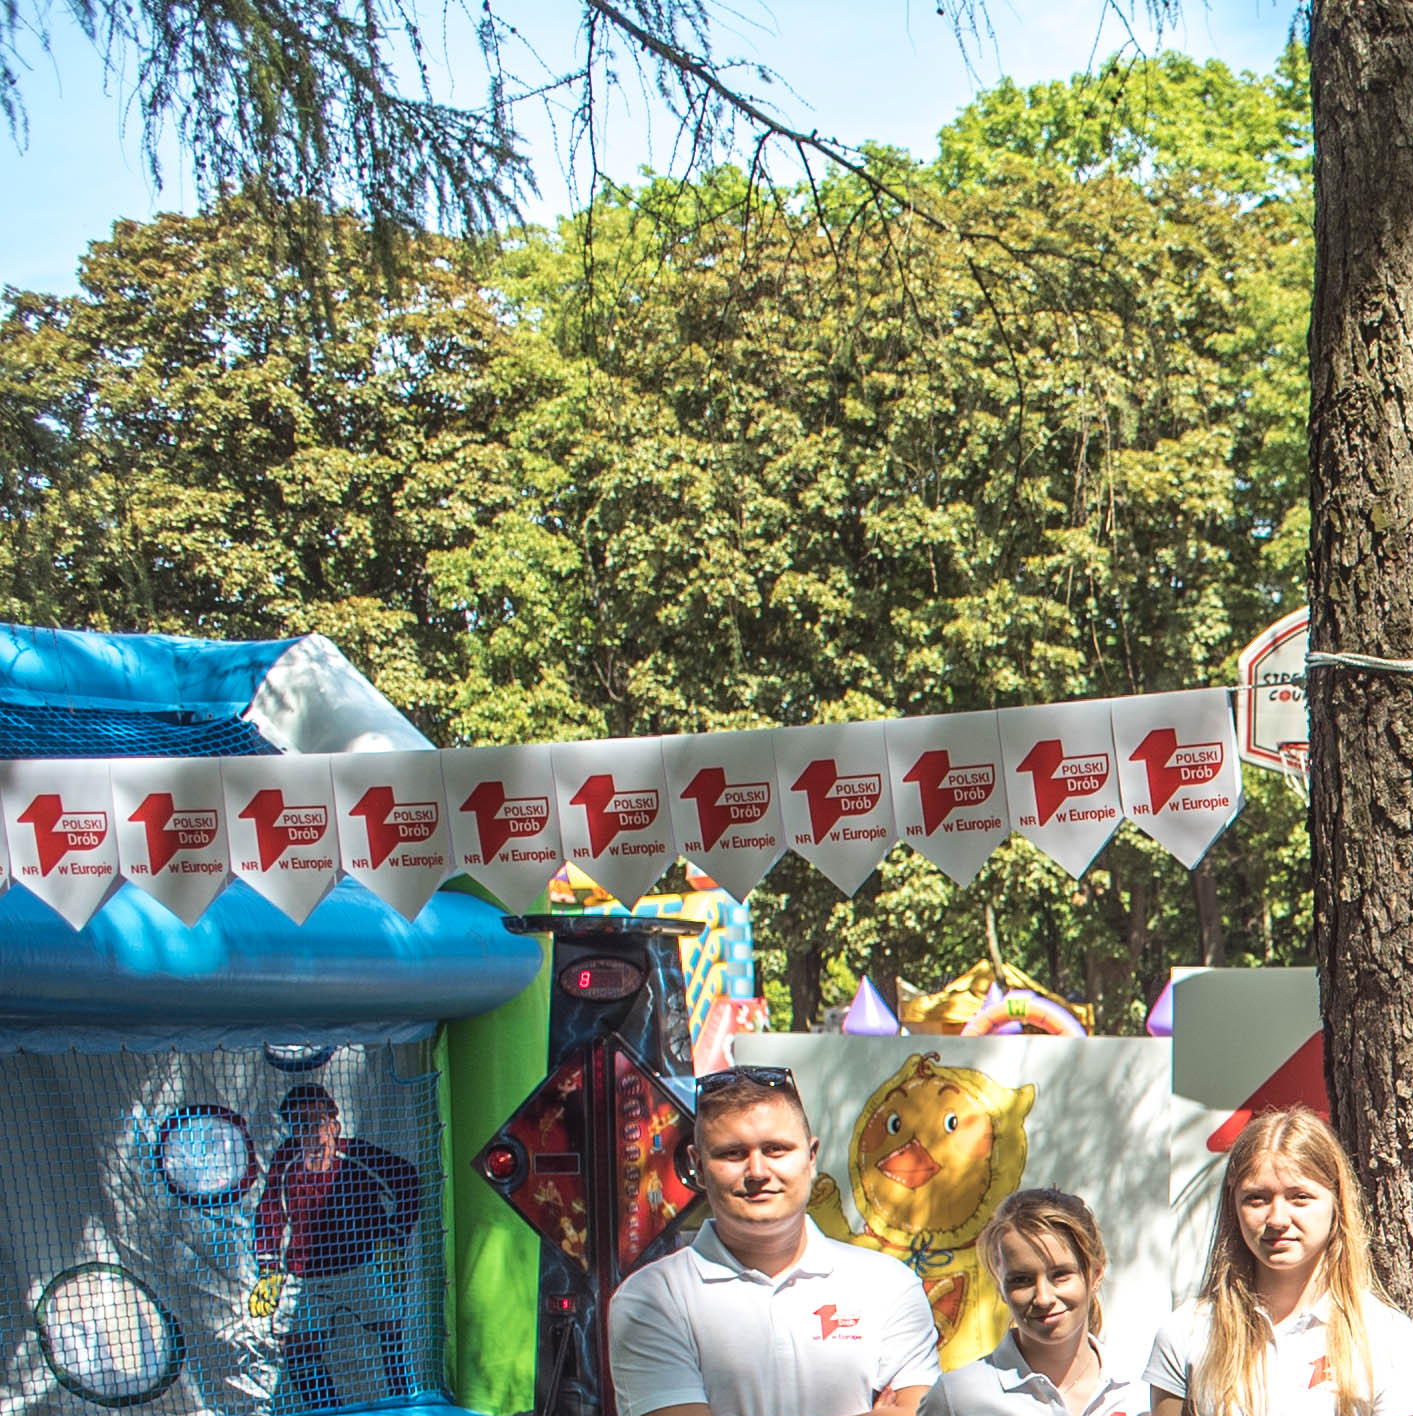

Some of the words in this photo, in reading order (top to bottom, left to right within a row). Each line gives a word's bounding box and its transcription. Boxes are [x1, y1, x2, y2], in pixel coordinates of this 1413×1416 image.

[1175, 750, 1218, 765] POLSKI
[1061, 761, 1104, 776] POLSKI
[1180, 764, 1213, 780] Drób
[948, 771, 990, 786] POLSKI
[1066, 775, 1099, 791] Drób
[835, 781, 876, 795] POLSKI
[953, 786, 986, 802] Drób
[613, 796, 655, 810] POLSKI
[724, 790, 768, 804] POLSKI
[840, 795, 872, 811] Drób
[1168, 802, 1179, 811] w
[1181, 795, 1229, 810] Europie
[393, 809, 436, 822] POLSKI
[503, 805, 544, 817] POLSKI
[729, 804, 761, 819] Drób
[1056, 813, 1068, 822] w
[1068, 806, 1115, 821] Europie
[1132, 804, 1149, 815] NR
[61, 819, 102, 830] POLSKI
[172, 816, 213, 829] POLSKI
[282, 813, 325, 826] POLSKI
[509, 818, 540, 832] Drób
[618, 811, 650, 826] Drób
[942, 823, 953, 832] w
[954, 816, 1001, 831] Europie
[1019, 815, 1036, 826] NR
[178, 827, 209, 844] Drób
[287, 826, 319, 840] Drób
[398, 823, 429, 837] Drób
[829, 832, 840, 841] w
[842, 826, 886, 840] Europie
[906, 825, 923, 836] NR
[67, 831, 99, 845] Drób
[719, 840, 731, 849] w
[731, 834, 776, 849] Europie
[498, 852, 510, 861] w
[511, 847, 556, 861] Europie
[609, 846, 620, 855] w
[621, 840, 665, 855] Europie
[278, 861, 289, 869] w
[290, 857, 333, 871] Europie
[351, 858, 368, 868] NR
[388, 858, 400, 867] w
[400, 854, 444, 868] Europie
[463, 853, 480, 864] NR
[21, 865, 39, 875] NR
[57, 865, 69, 874] w
[69, 862, 112, 876] Europie
[130, 864, 148, 874] NR
[168, 863, 179, 872] w
[180, 859, 223, 873] Europie
[241, 861, 258, 871] NR
